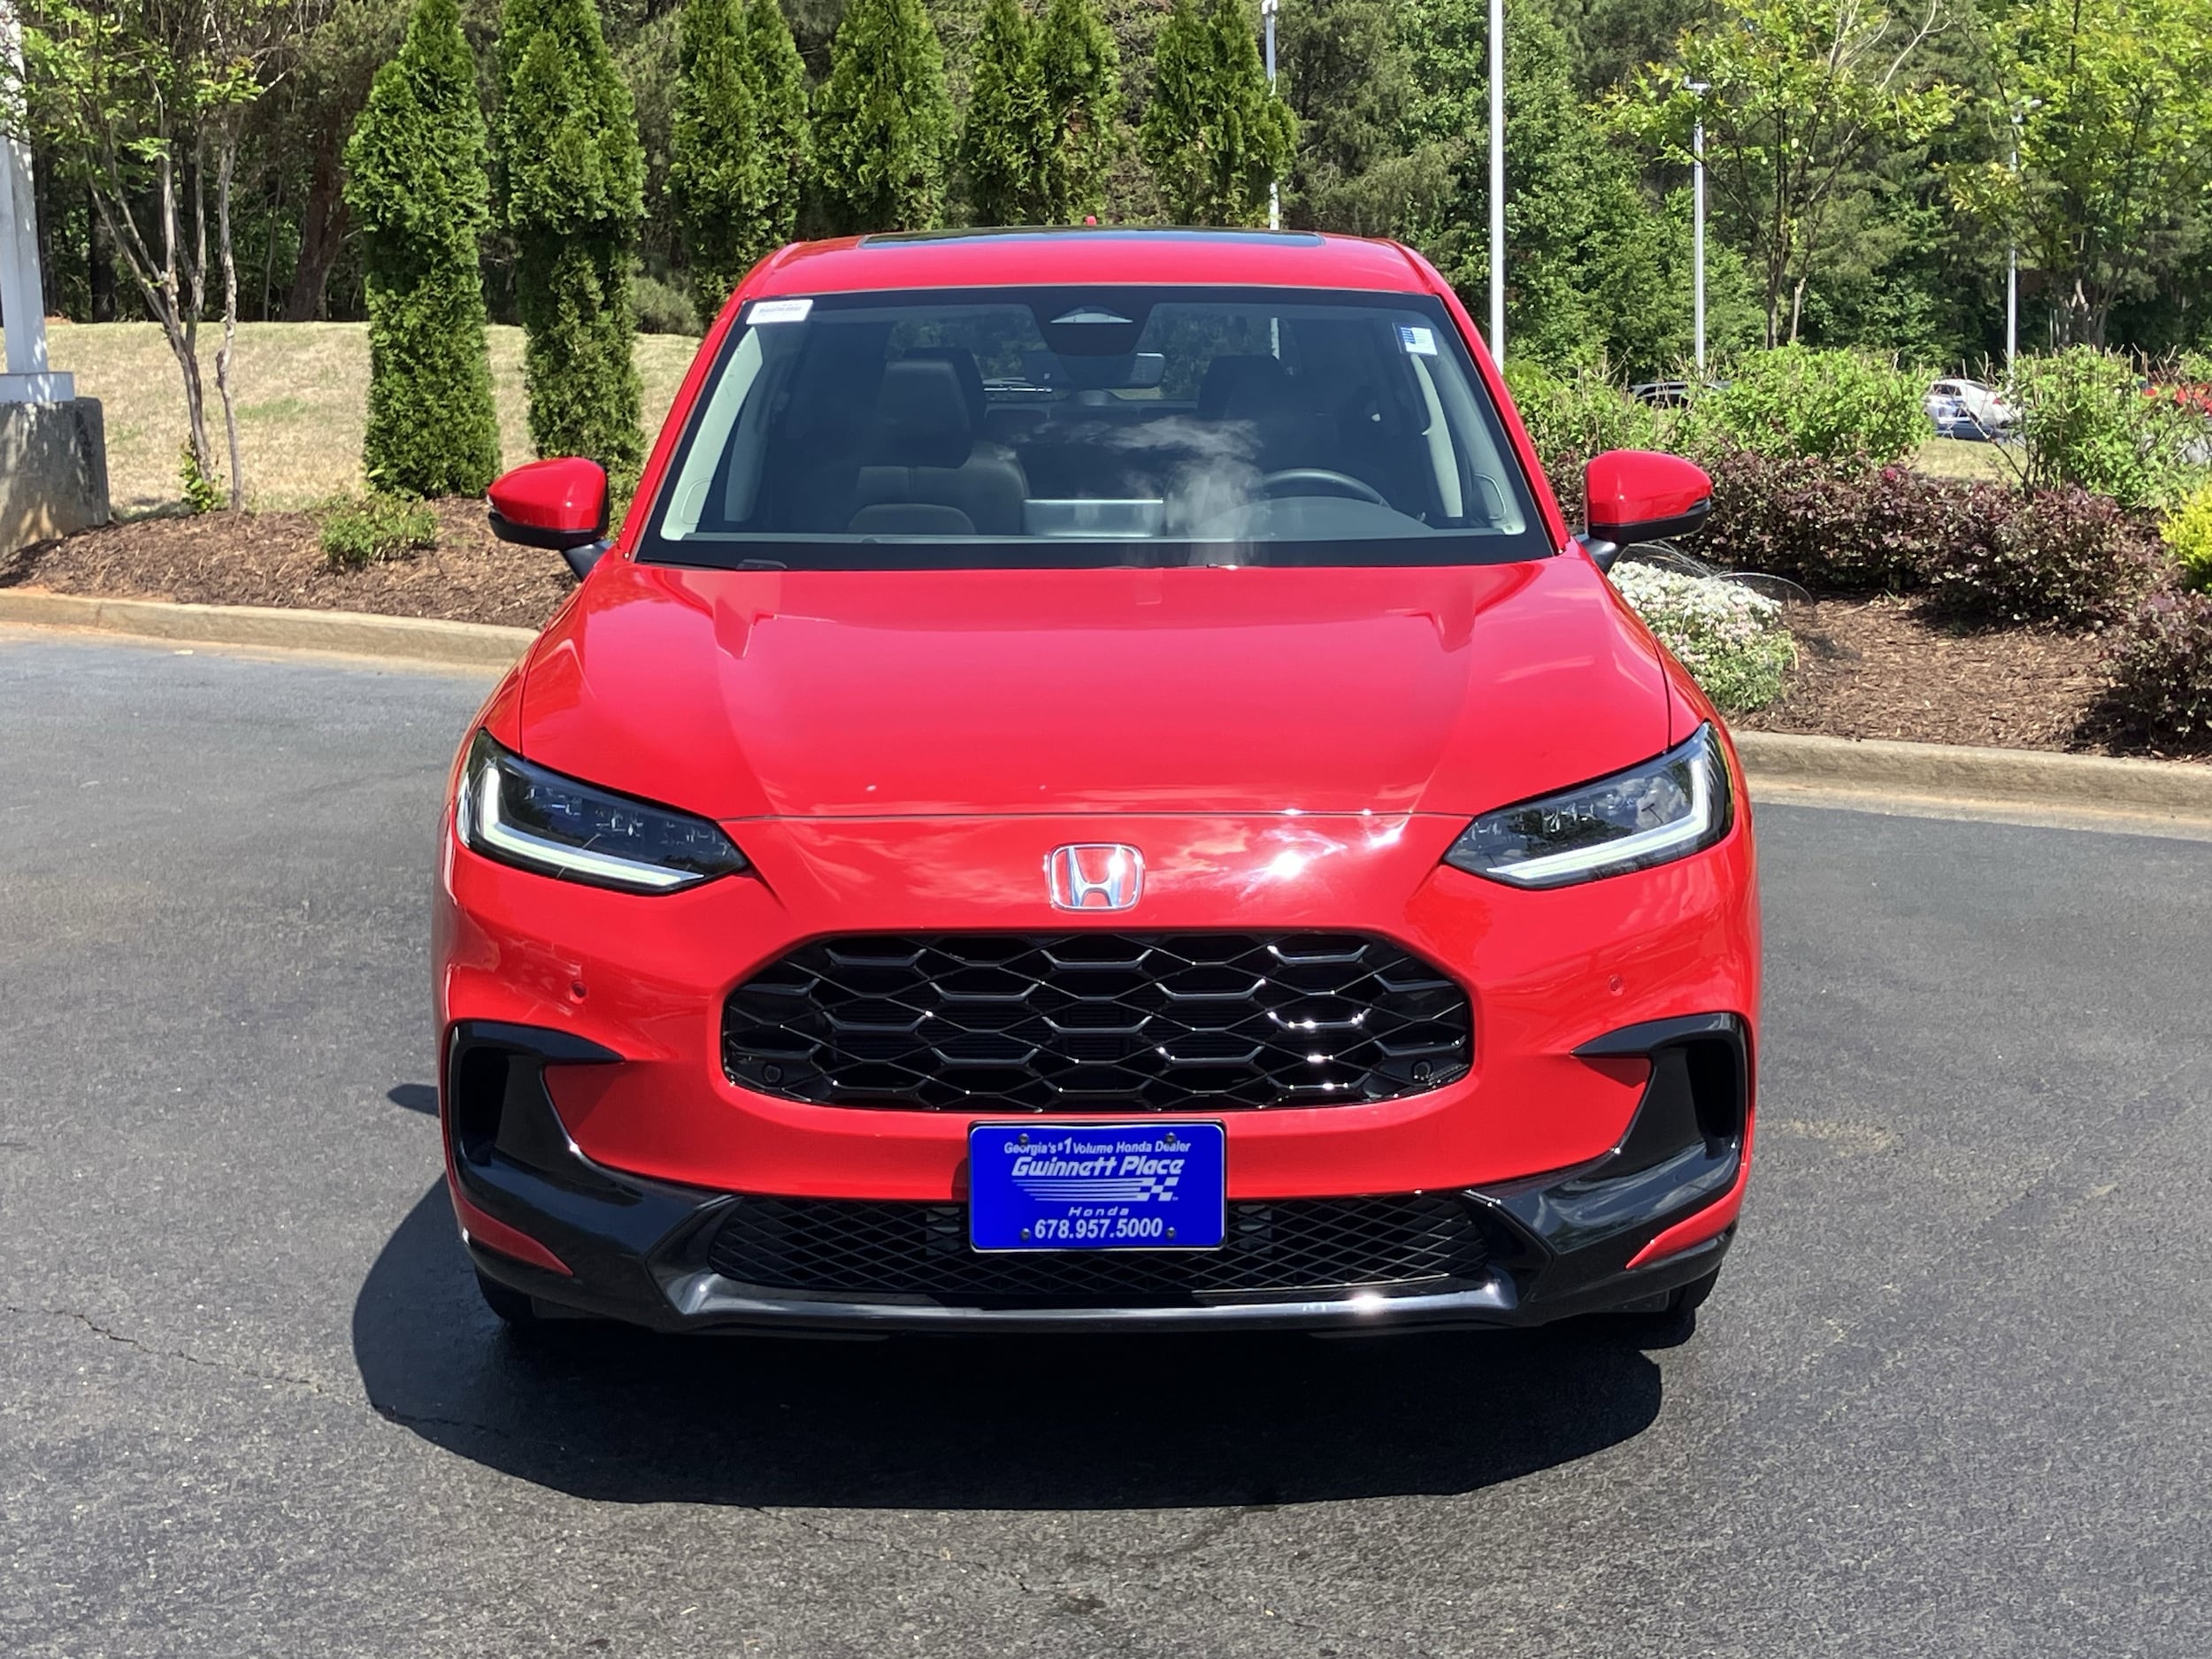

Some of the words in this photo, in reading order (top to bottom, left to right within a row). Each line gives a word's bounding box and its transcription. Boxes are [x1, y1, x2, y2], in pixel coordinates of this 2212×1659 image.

[1004, 1141, 1056, 1156] Georgia's
[1072, 1142, 1113, 1154] Volume
[1116, 1141, 1152, 1153] Honda
[1155, 1141, 1191, 1153] Dealer
[1011, 1156, 1117, 1177] Gwinnett
[1119, 1156, 1185, 1175] Place
[1068, 1206, 1129, 1217] Honda
[1034, 1217, 1164, 1240] 678.957.5000
